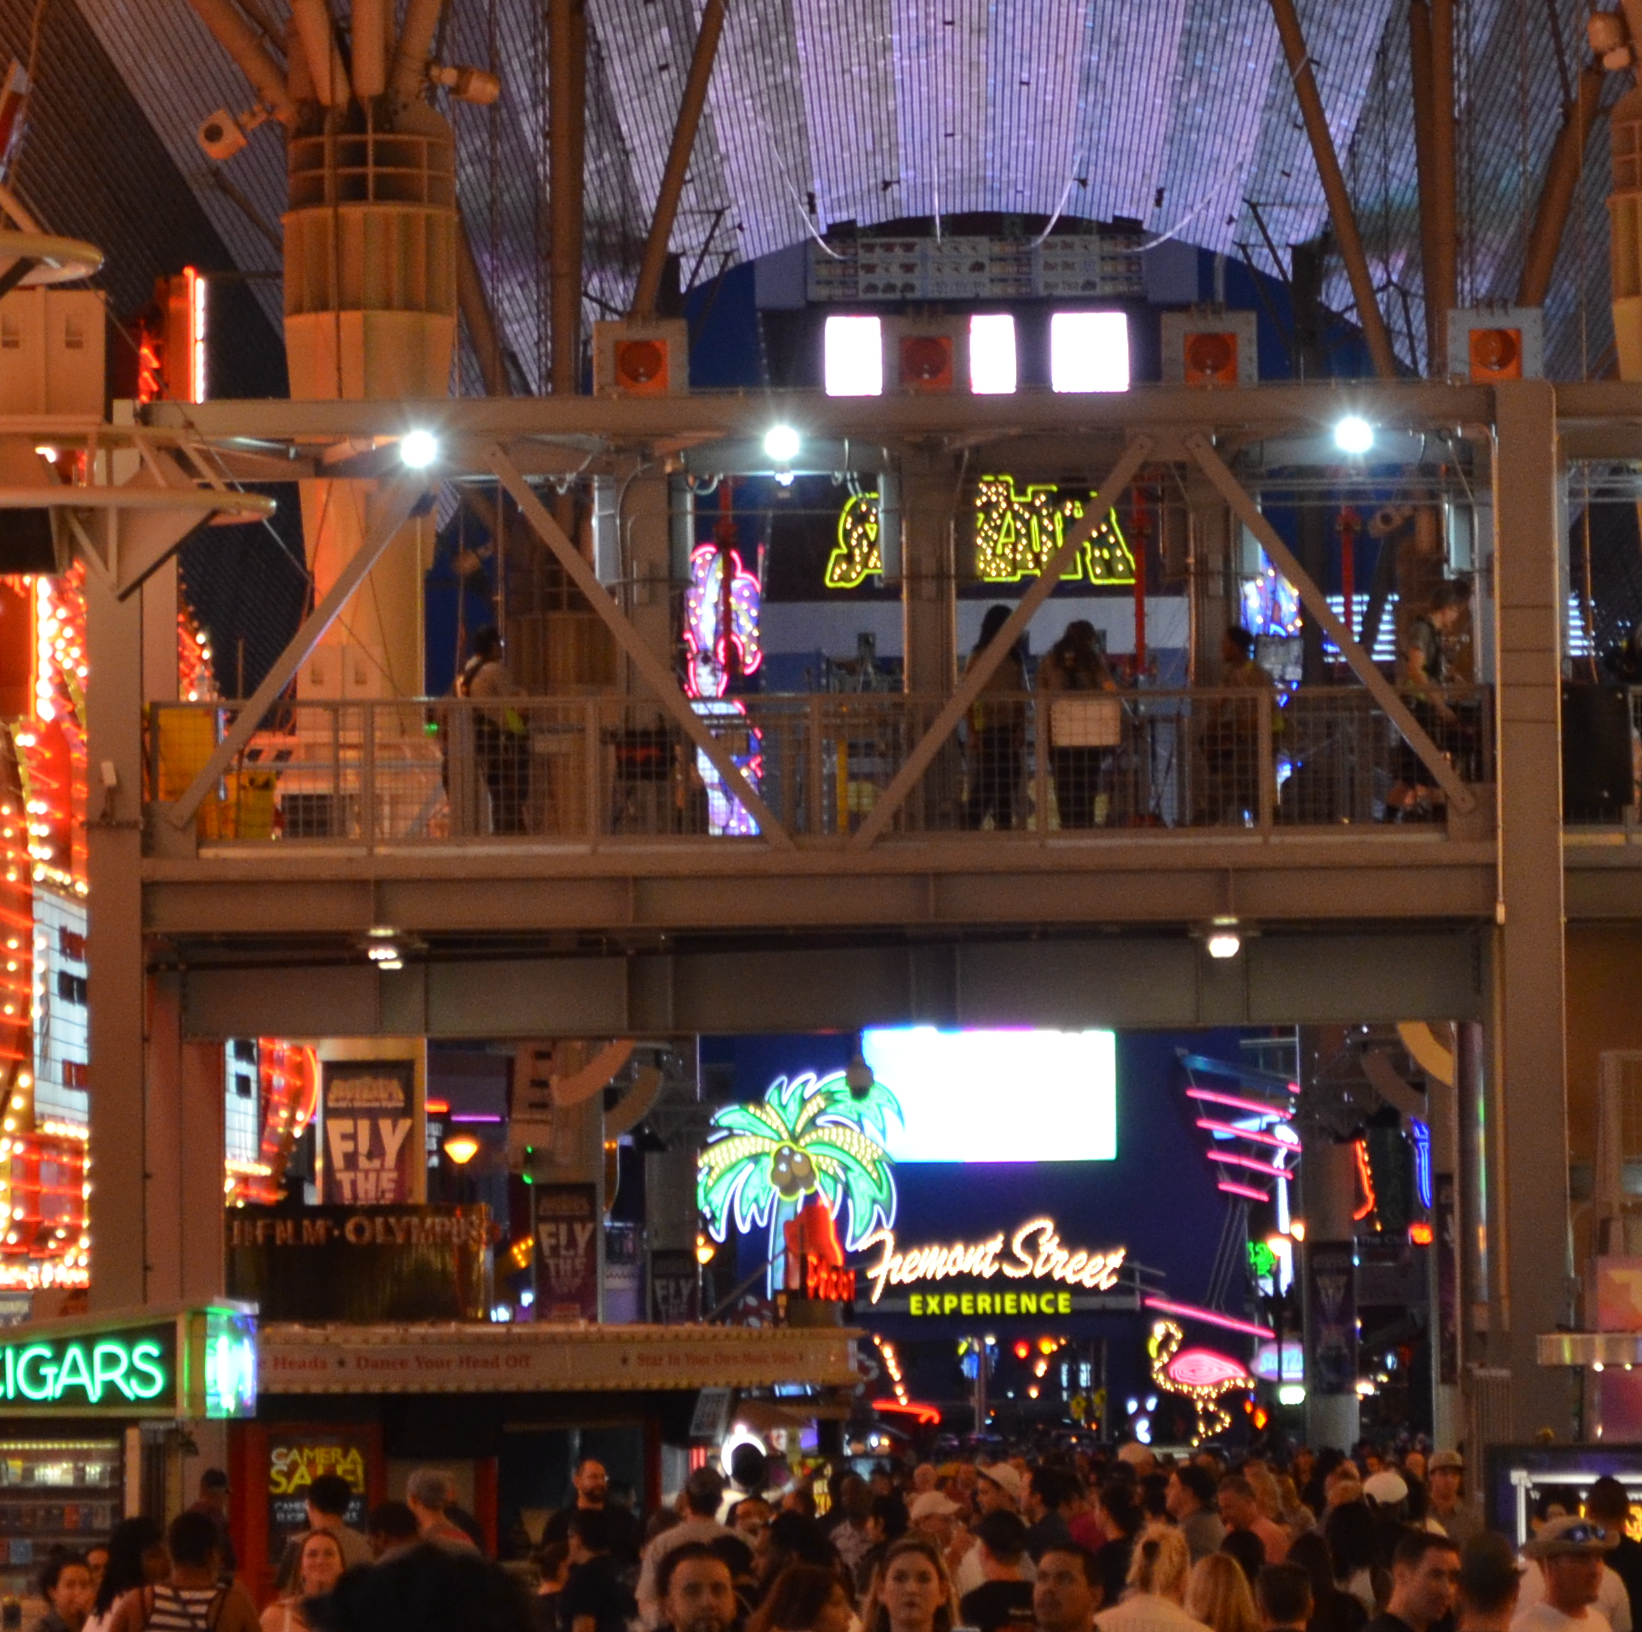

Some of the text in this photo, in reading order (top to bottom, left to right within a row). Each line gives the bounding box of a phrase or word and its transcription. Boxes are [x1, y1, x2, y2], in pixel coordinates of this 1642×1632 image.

[326, 1118, 413, 1169] FLY
[336, 1171, 398, 1200] THE
[343, 1213, 482, 1246] OLYMPUS
[538, 1222, 595, 1257] FLY
[545, 1258, 587, 1275] THE
[857, 1216, 1127, 1305] Fremont Street
[654, 1278, 695, 1303] FLY
[909, 1292, 1072, 1315] EXPERIENCE
[272, 1355, 328, 1369] Heads
[357, 1355, 407, 1369] Dance
[414, 1354, 453, 1369] Your
[459, 1353, 500, 1369] Head
[505, 1353, 531, 1369] Off
[271, 1447, 363, 1465] CAMERA
[269, 1463, 364, 1495] SAE!
